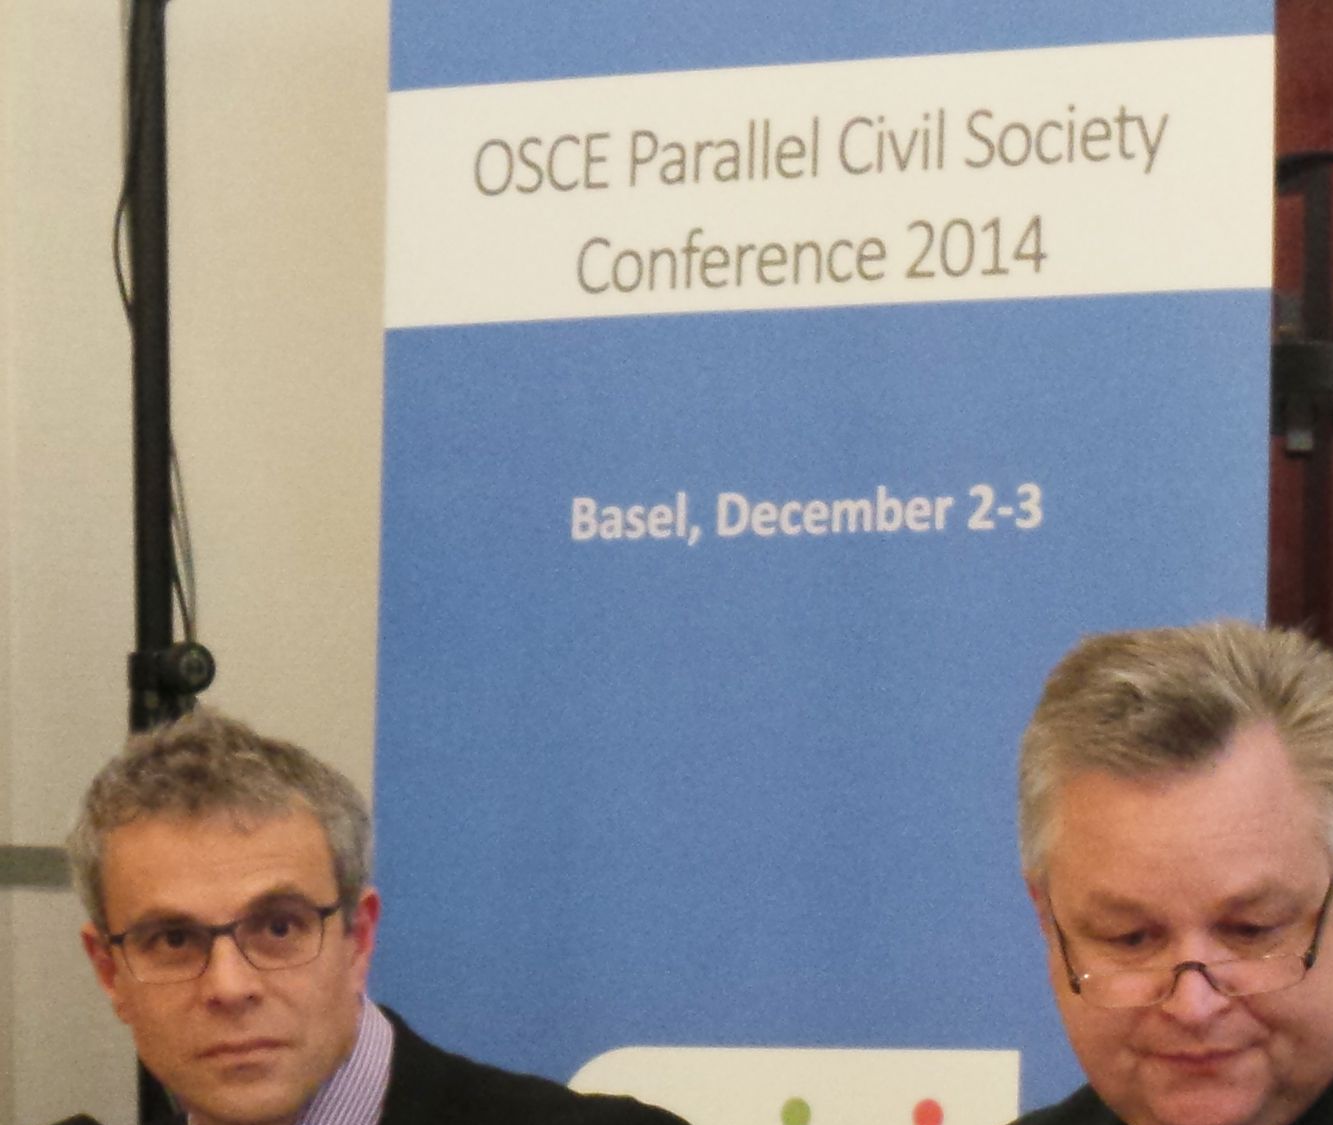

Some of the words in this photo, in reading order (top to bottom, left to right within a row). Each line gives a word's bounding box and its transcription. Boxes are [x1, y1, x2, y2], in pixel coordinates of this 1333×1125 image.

[474, 132, 610, 197] OSCE
[629, 117, 820, 188] Parallel
[839, 109, 945, 175] Civil
[965, 104, 1169, 174] Society
[577, 228, 887, 295] Conference
[906, 215, 1048, 280] 2014
[571, 490, 702, 545] Basel,
[716, 486, 952, 537] December
[968, 483, 1044, 531] 2-3
